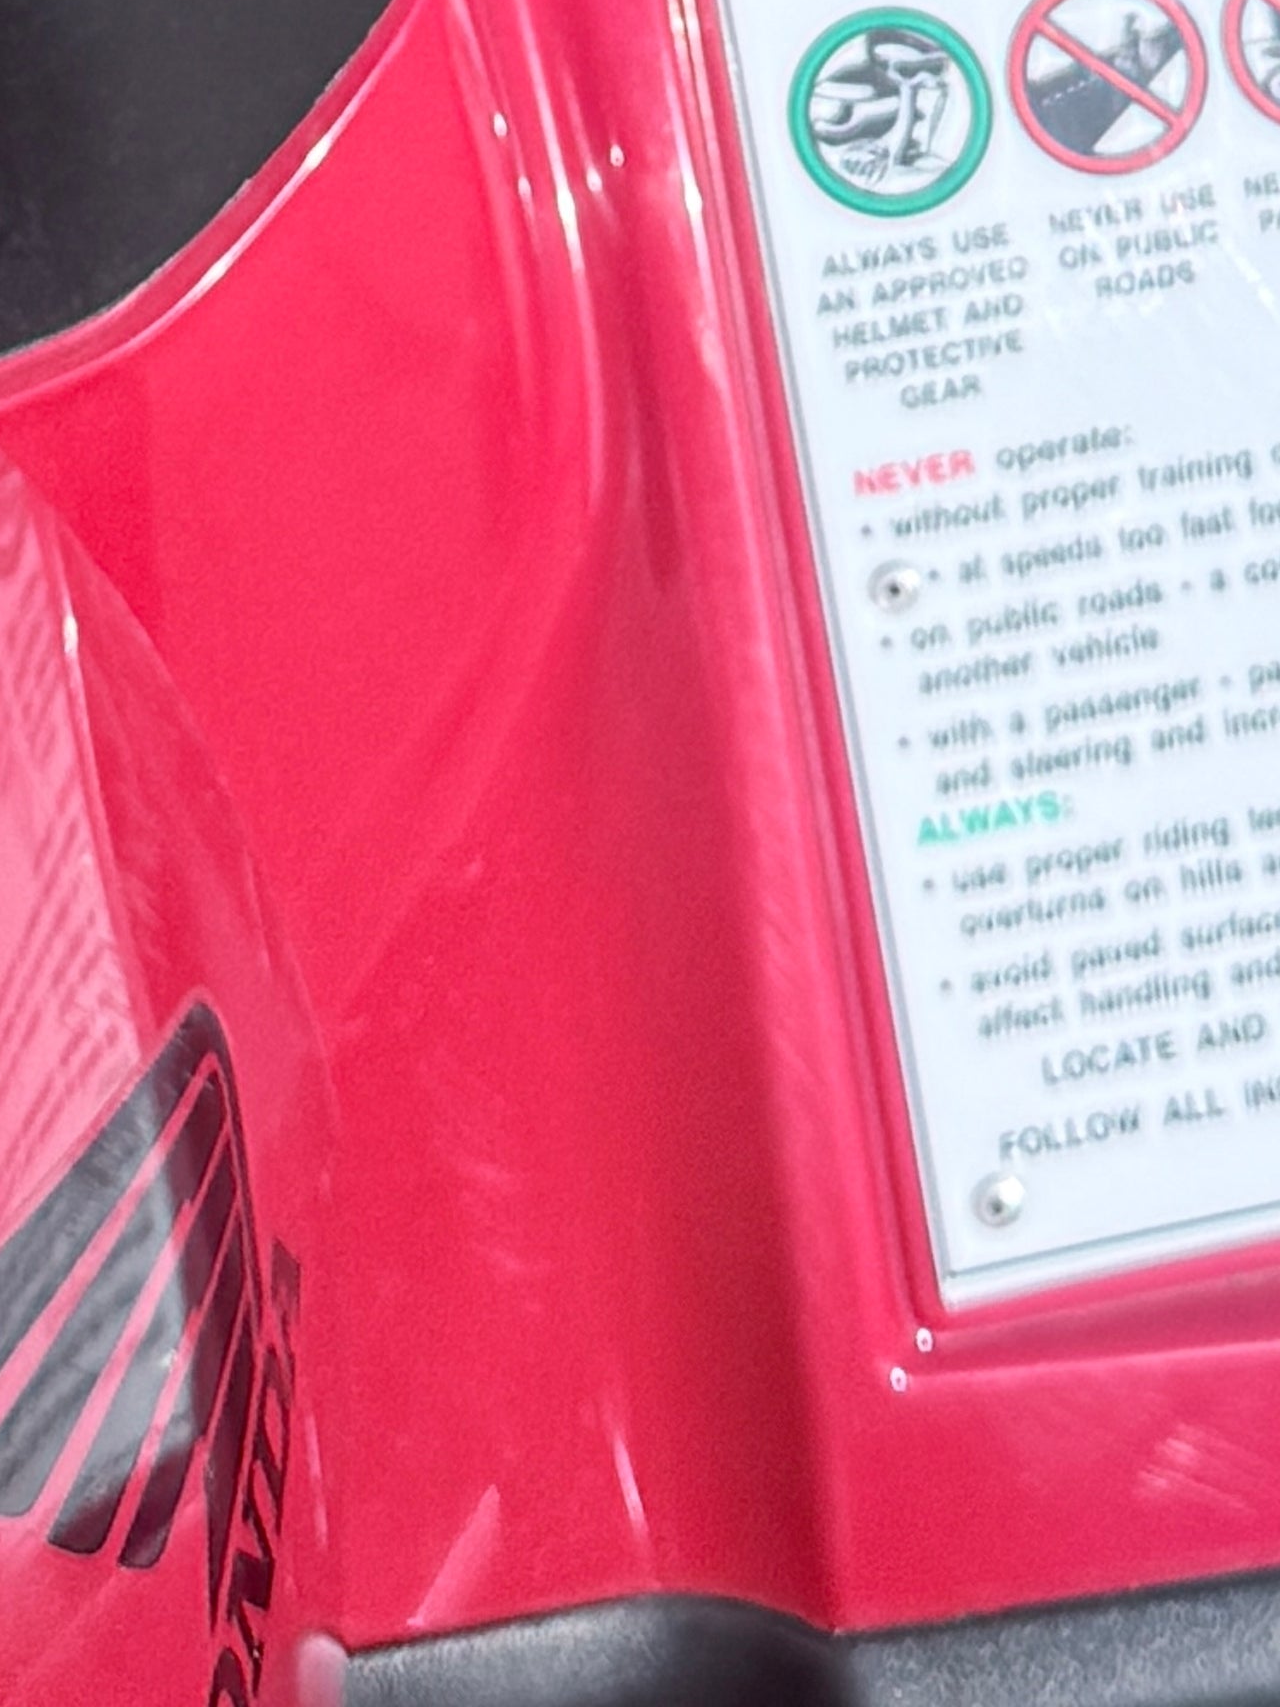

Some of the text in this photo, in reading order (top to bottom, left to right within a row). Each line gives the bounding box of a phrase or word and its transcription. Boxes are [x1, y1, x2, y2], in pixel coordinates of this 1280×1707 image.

[821, 222, 1009, 278] ALWAYS USE
[1057, 218, 1218, 271] ON PUBLIC
[1094, 259, 1196, 298] ROADS
[815, 255, 1027, 316] AN APPROVED
[831, 292, 1024, 348] HELMET AND
[844, 329, 1023, 383] PROTECTIVE
[899, 373, 982, 410] GEAR
[853, 449, 974, 494] NEVER
[889, 494, 1005, 538] without
[1020, 474, 1119, 520] proper
[1137, 449, 1254, 491] training
[957, 553, 987, 585] at
[1000, 535, 1103, 578] speeds
[1117, 522, 1165, 553] too
[1179, 505, 1235, 540] fast
[909, 623, 952, 652] on
[966, 600, 1058, 645] public
[1076, 579, 1164, 616] roads
[1208, 567, 1228, 594] a
[918, 624, 1159, 695] another vehicle
[927, 715, 993, 750] with
[1008, 709, 1027, 736] a
[1044, 677, 1199, 733] passenger
[935, 757, 993, 796] and
[1009, 735, 1134, 781] steering
[1149, 715, 1207, 753] and
[951, 862, 1007, 894] use
[1024, 837, 1122, 885] proper
[1142, 816, 1231, 854] riding
[959, 887, 1106, 938] overturns
[1122, 875, 1165, 904] on
[1179, 858, 1244, 891] hills
[970, 951, 1053, 994] avoid
[1070, 928, 1163, 979] paved
[977, 996, 1064, 1039] affect
[1079, 969, 1213, 1016] handling
[1041, 1030, 1175, 1086] LOCATE
[1196, 1012, 1267, 1051] AND
[998, 1107, 1140, 1160] FOLLOW
[1162, 1089, 1225, 1126] ALL
